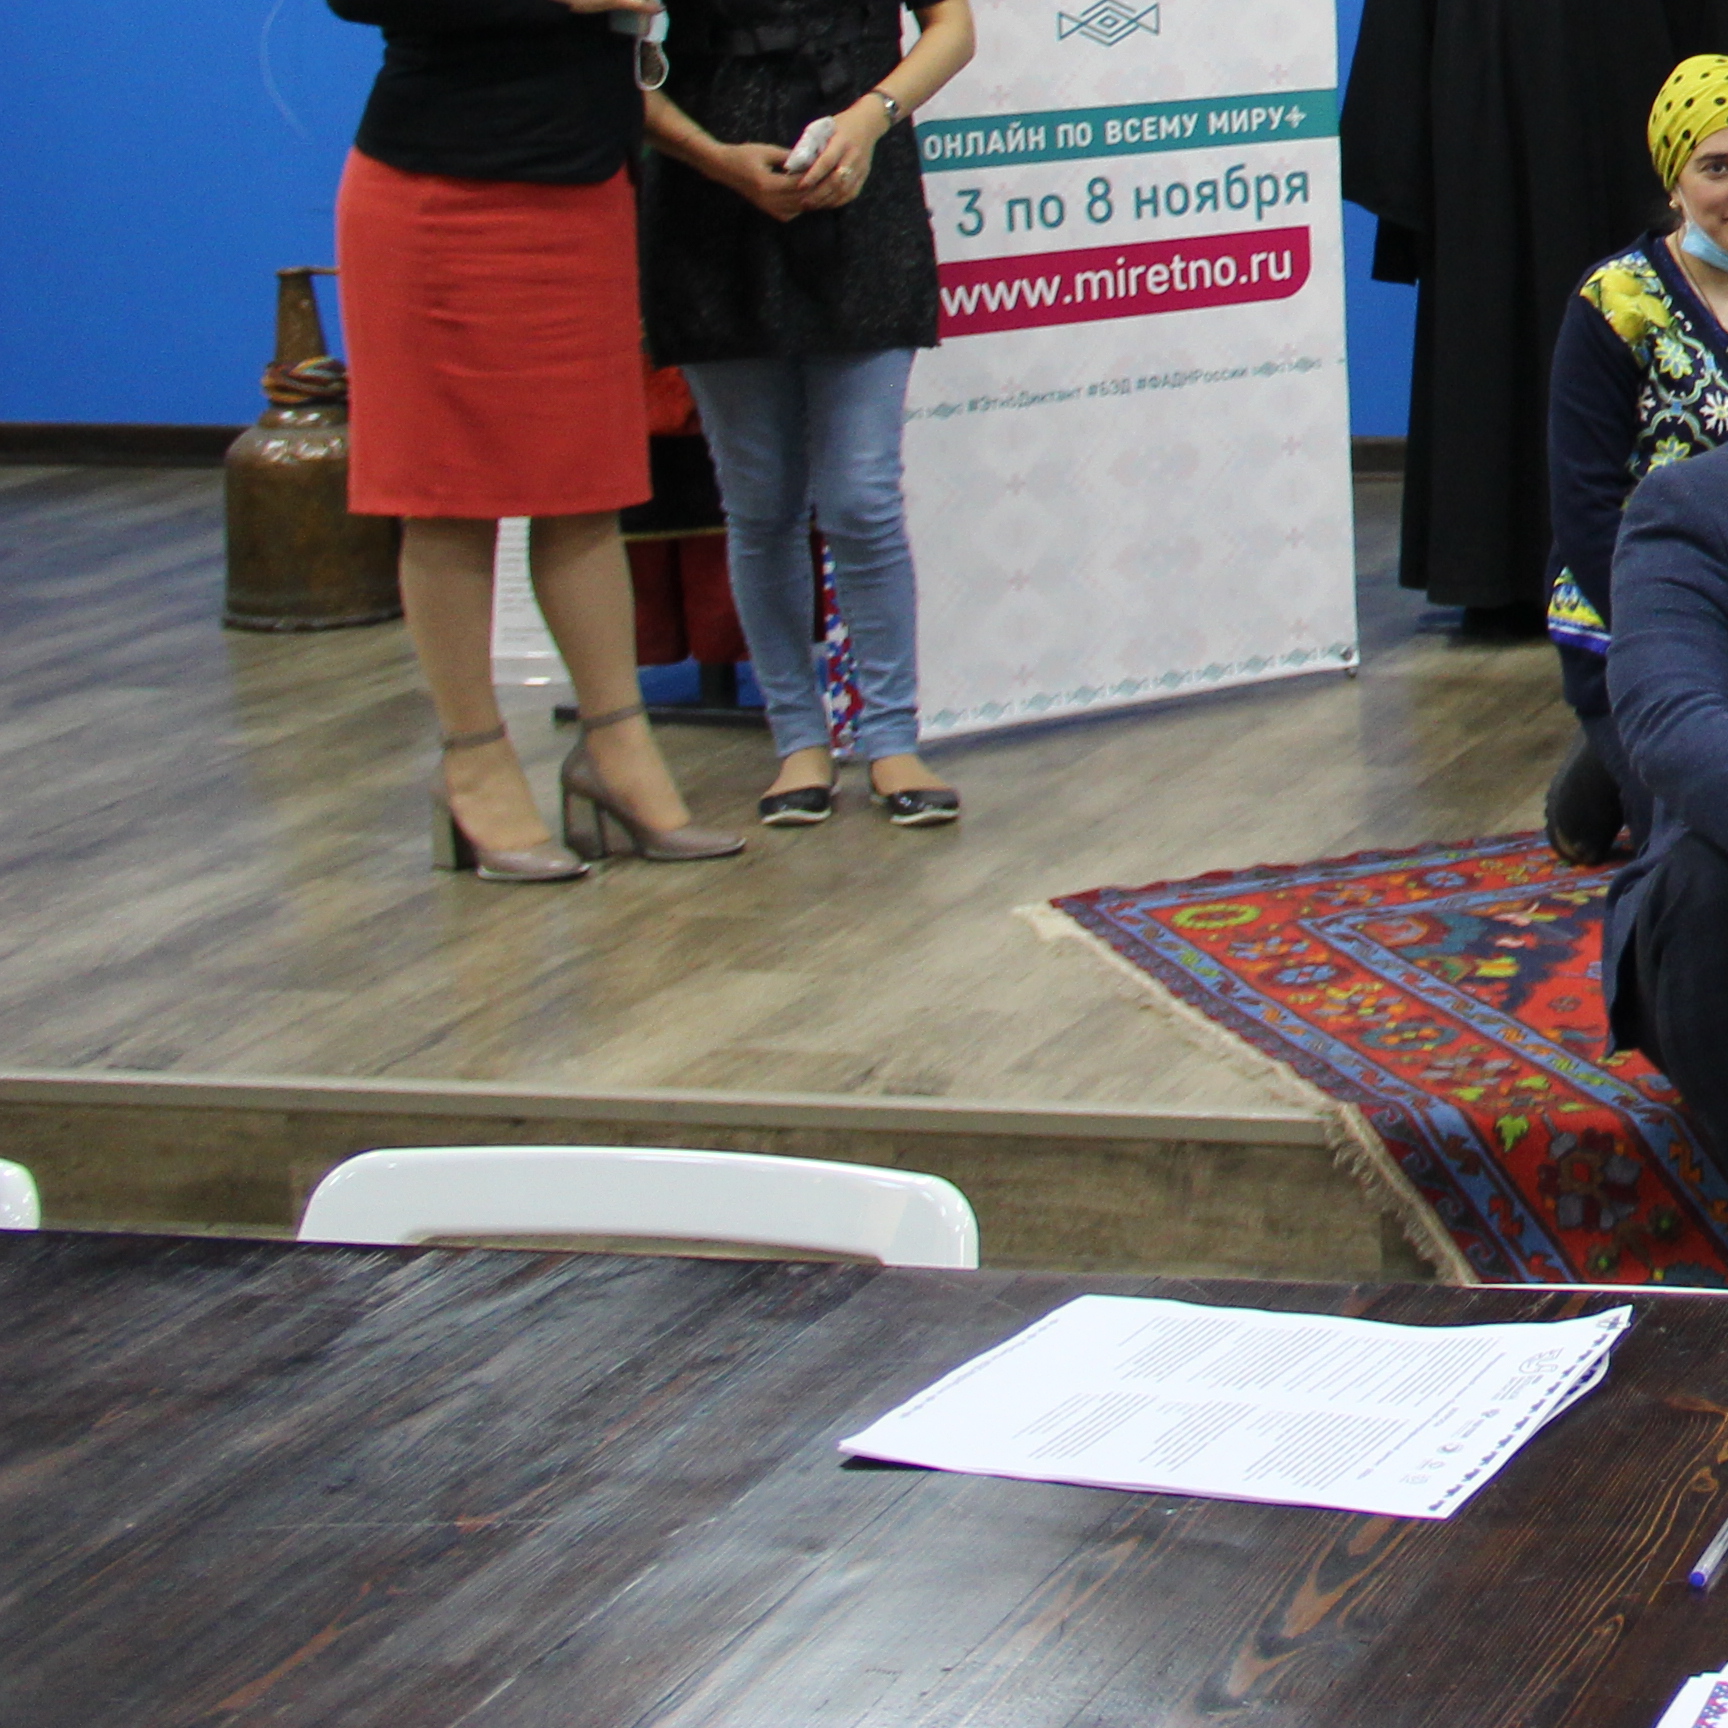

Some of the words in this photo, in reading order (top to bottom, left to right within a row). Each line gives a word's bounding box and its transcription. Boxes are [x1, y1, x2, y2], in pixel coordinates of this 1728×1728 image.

[923, 121, 1047, 161] ОНЛАЙН
[1056, 122, 1093, 149] ПО
[1105, 112, 1199, 145] ВСЕМУ
[1208, 106, 1285, 136] МИРУ
[956, 187, 984, 238] 3
[1006, 193, 1065, 234] по
[1086, 176, 1114, 225] 8
[1133, 163, 1311, 221] ноября
[940, 247, 1293, 318] www.miretno.ru
